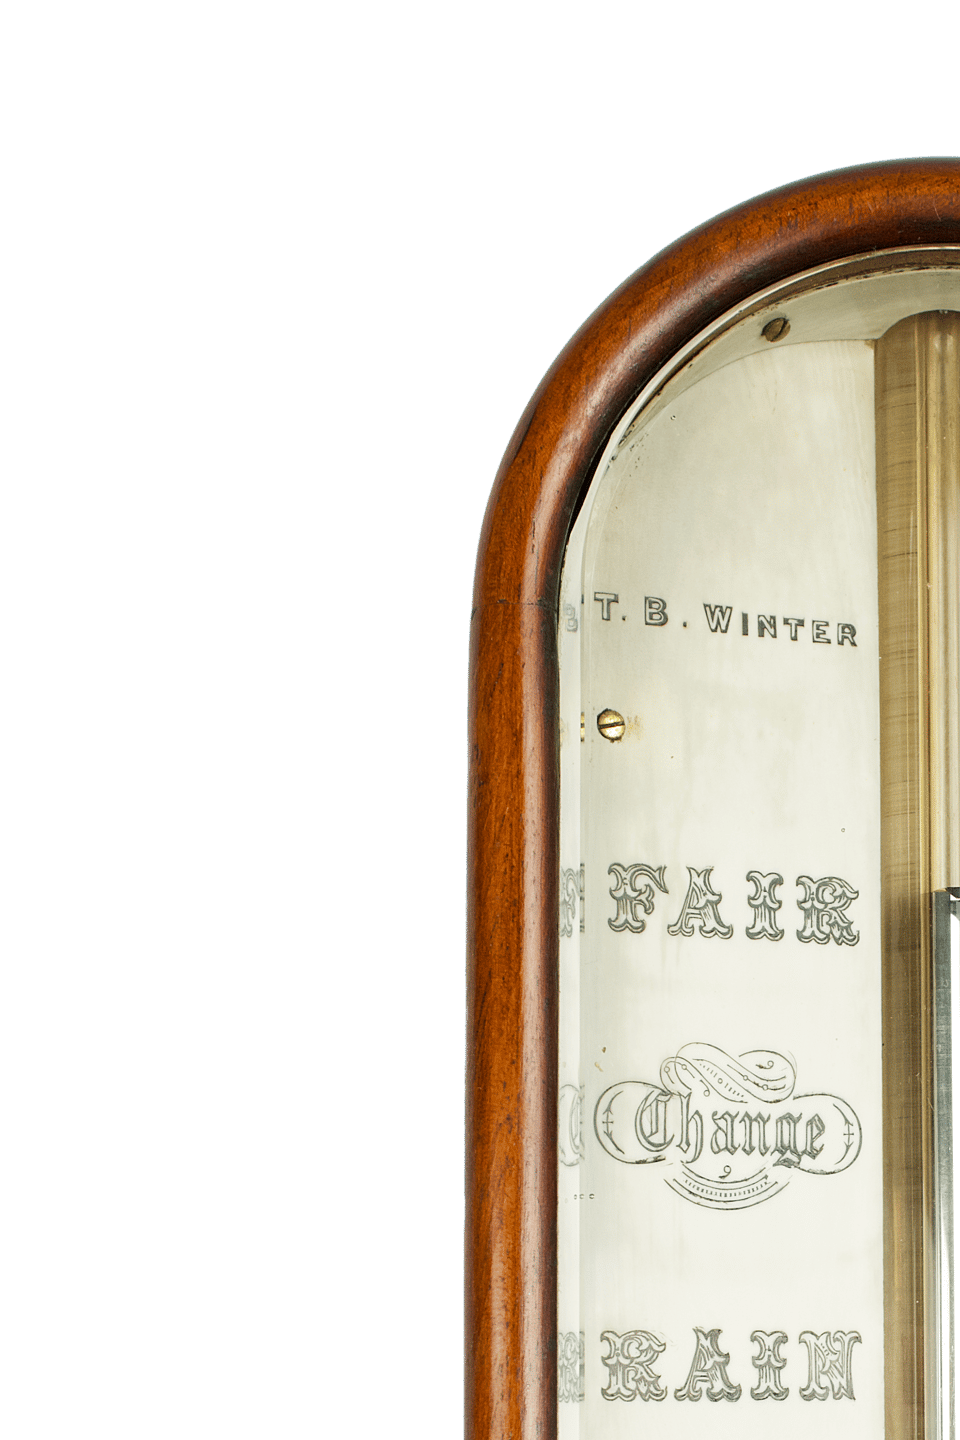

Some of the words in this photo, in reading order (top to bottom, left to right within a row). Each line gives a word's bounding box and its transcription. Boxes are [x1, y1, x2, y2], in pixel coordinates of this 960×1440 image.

[703, 603, 857, 647] WINTER
[608, 862, 860, 947] FAIR
[633, 1084, 828, 1170] Change
[600, 1327, 862, 1402] RAIN
